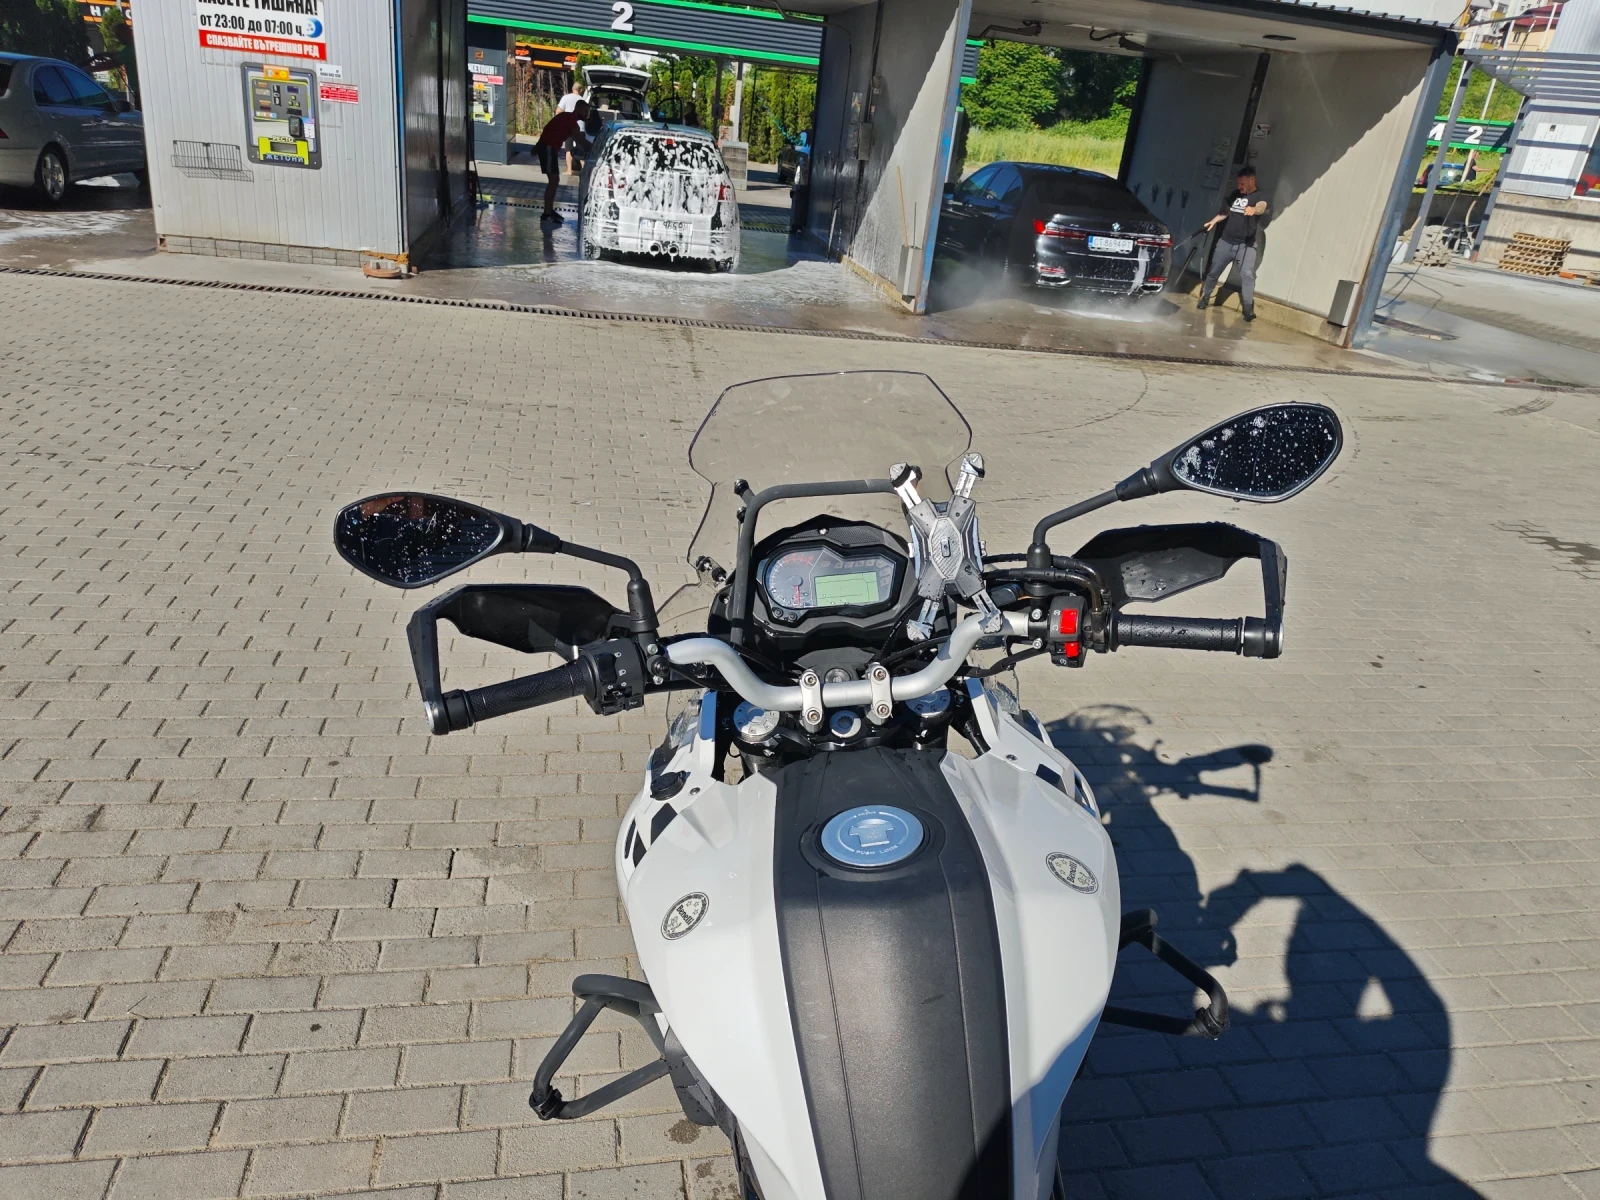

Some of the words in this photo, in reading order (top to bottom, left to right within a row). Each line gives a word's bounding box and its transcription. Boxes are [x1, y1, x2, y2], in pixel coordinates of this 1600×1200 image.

[200, 14, 212, 27] от
[214, 13, 245, 30] 23:00
[248, 20, 262, 33] до
[265, 19, 293, 35] 07:00
[611, 1, 634, 31] 2
[206, 33, 253, 50] СПАЗВАЙТЕ
[303, 43, 320, 58] РЕД
[1464, 125, 1483, 144] 2
[266, 153, 304, 163] ЖЕТОНИ
[676, 904, 694, 925] Benelli
